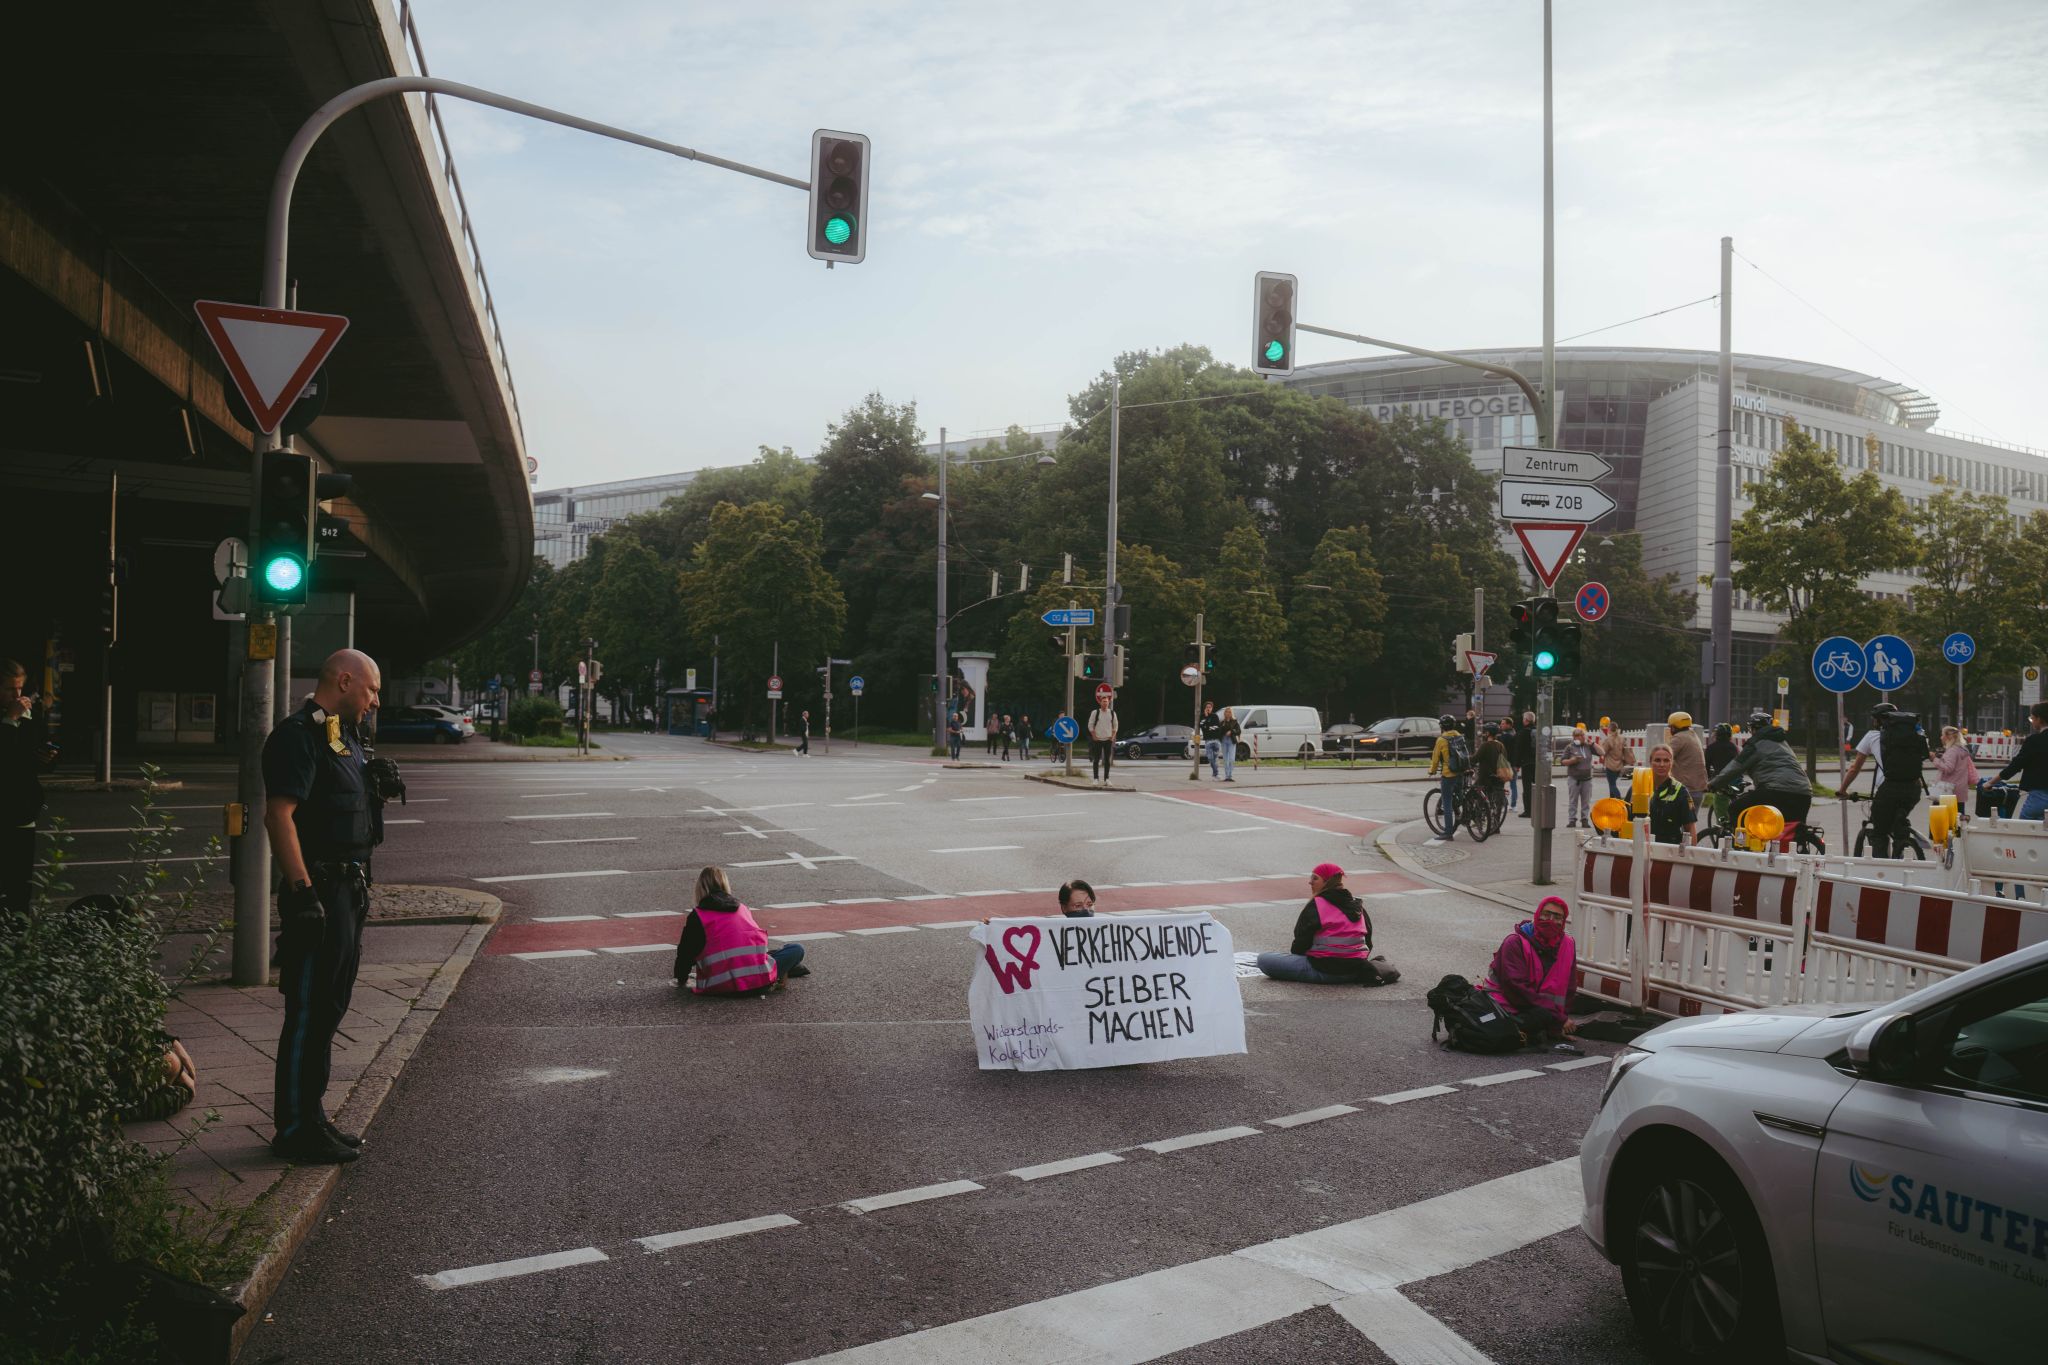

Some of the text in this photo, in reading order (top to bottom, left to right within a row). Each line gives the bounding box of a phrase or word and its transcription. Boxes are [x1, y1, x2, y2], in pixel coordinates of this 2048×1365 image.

[1733, 394, 1766, 413] mundi
[1526, 457, 1579, 473] Zentrum
[1556, 496, 1583, 510] ZOB
[321, 528, 338, 537] 542
[1048, 923, 1218, 970] VERKEHRSWENDE
[1085, 973, 1191, 1009] SELBER
[1088, 1006, 1194, 1044] MACHEN
[989, 1039, 1048, 1063] Kollektiv
[1888, 1221, 1905, 1238] Für
[1908, 1228, 1985, 1266] Lebensräume
[1989, 1258, 2009, 1274] mit
